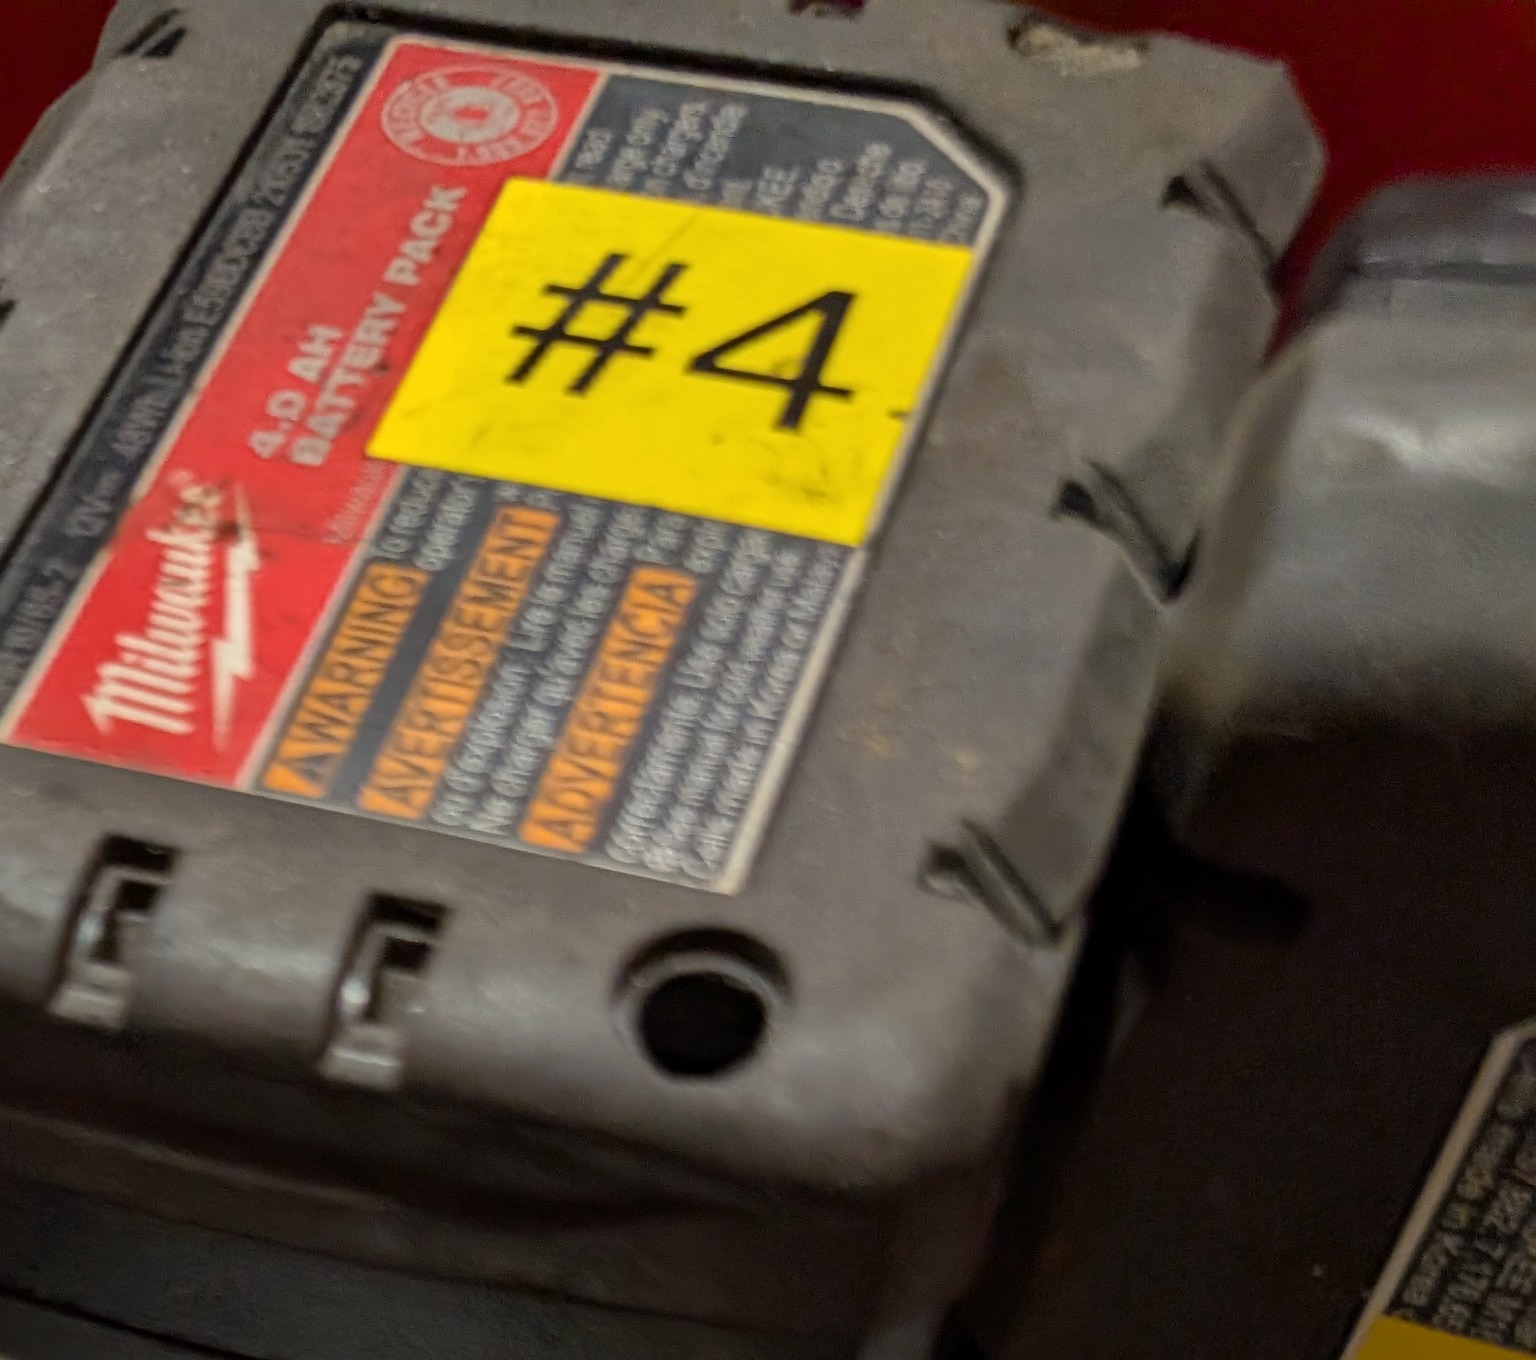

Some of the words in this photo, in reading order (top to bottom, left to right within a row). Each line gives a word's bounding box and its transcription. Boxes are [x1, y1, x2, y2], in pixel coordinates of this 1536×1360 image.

[248, 389, 306, 460] 4.0
[287, 323, 345, 384] AH
[288, 292, 407, 467] BATTERY
[383, 185, 468, 286] PACK
[504, 250, 855, 432] #4
[79, 484, 222, 737] Milwaukee
[297, 567, 418, 748] WARNING
[374, 508, 554, 806] AVERTISSEMENT
[537, 577, 685, 847] ADVERTENCIA
